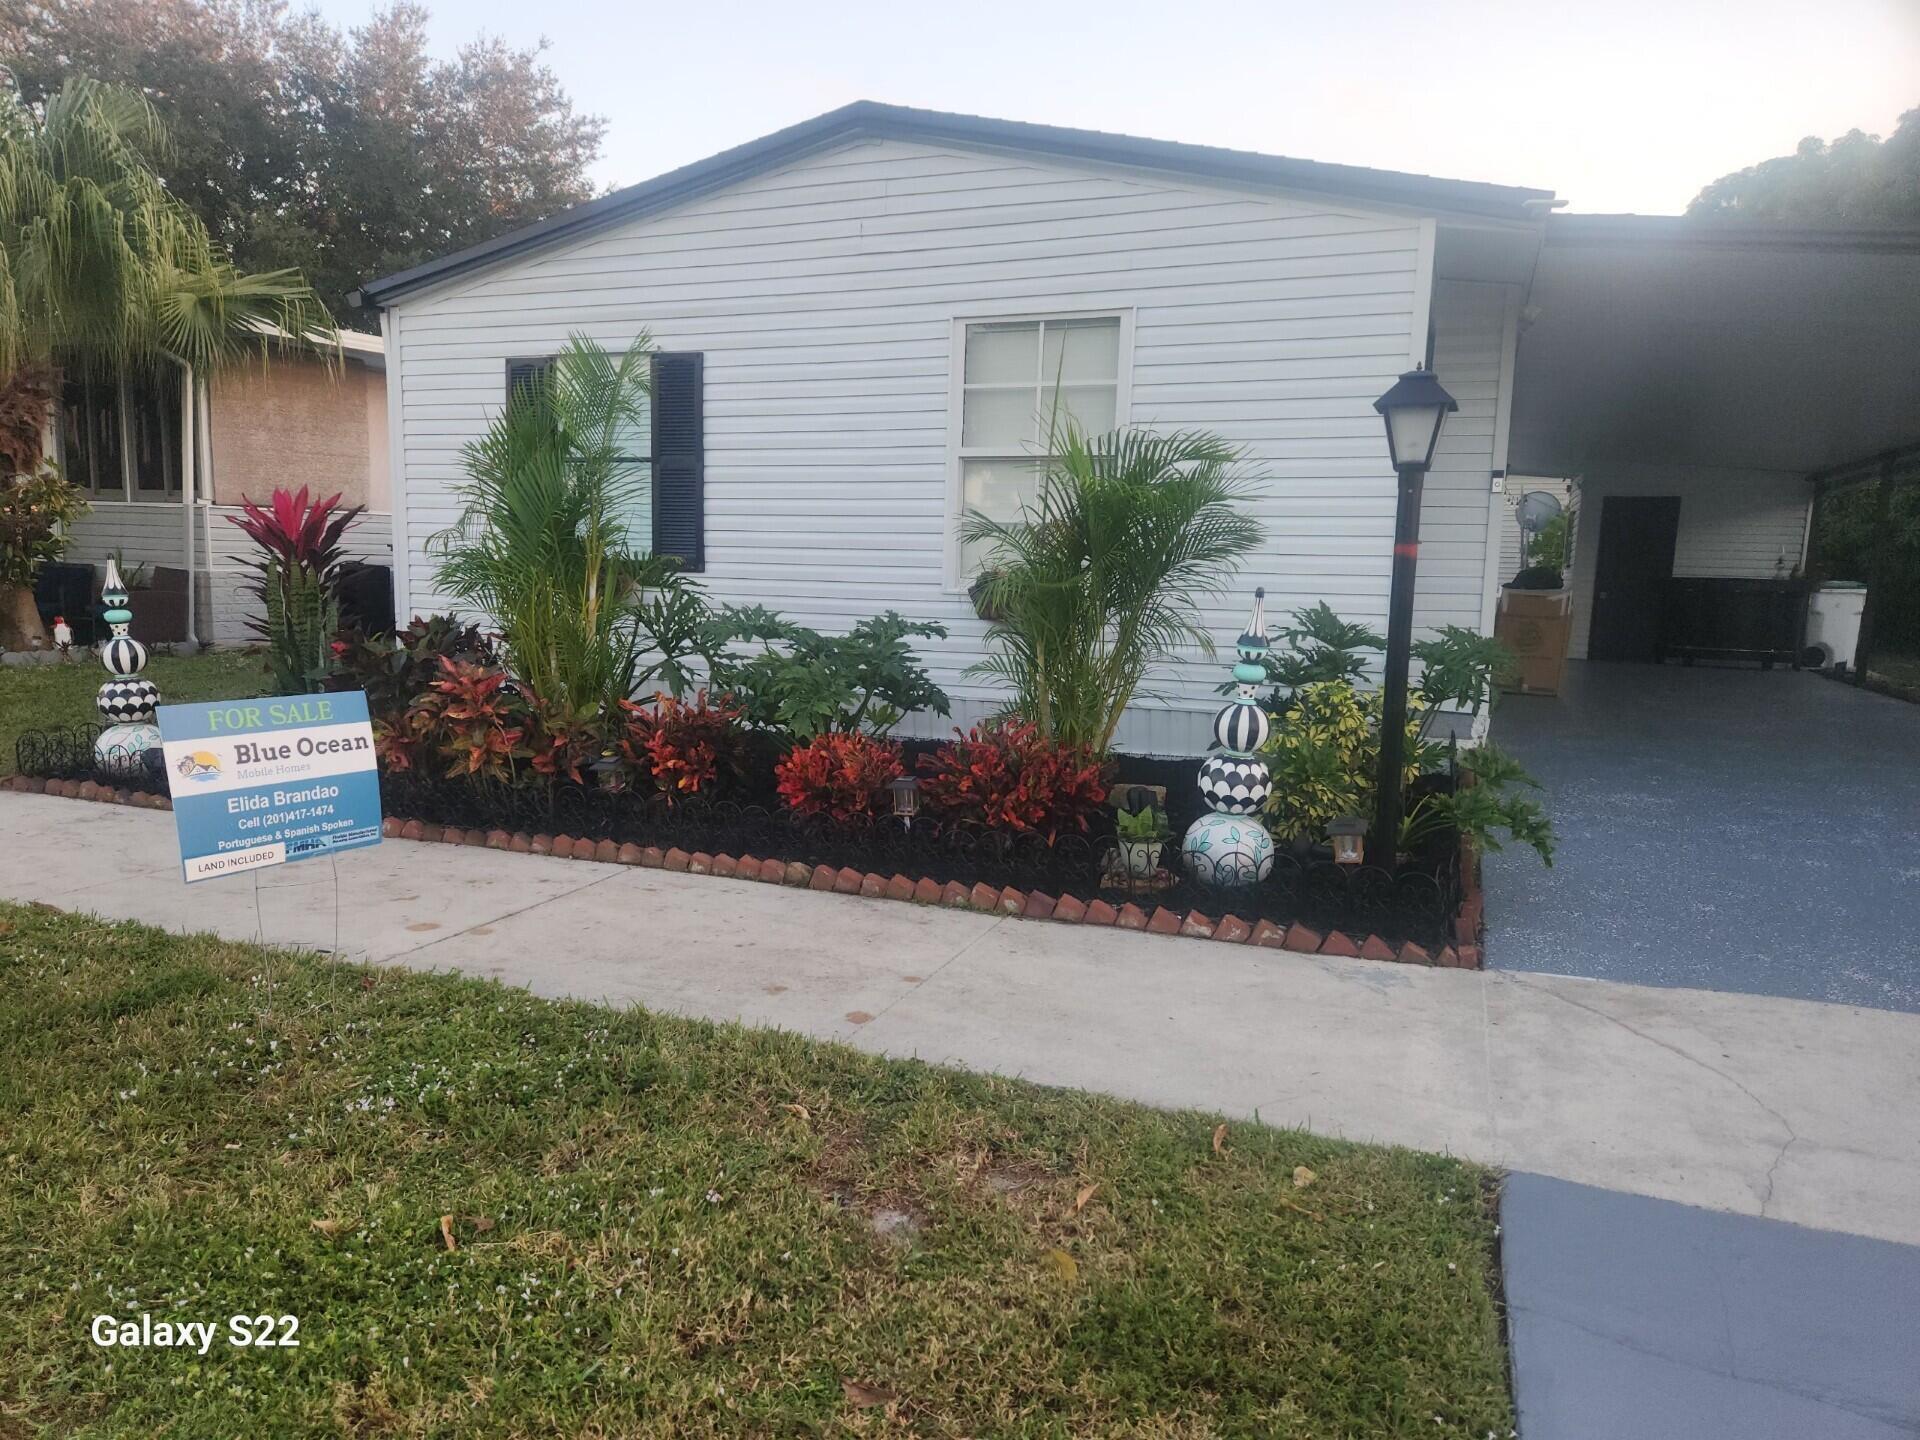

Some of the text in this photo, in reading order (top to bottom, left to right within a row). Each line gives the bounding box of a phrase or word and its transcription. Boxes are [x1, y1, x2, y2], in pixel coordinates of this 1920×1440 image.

[208, 701, 334, 731] FOR SALE
[234, 736, 369, 765] Blue Ocean
[237, 763, 311, 780] Mobile Homes
[228, 785, 339, 813] Elida Brandao
[238, 804, 334, 830] Cell (201)417-1474
[218, 834, 273, 851] Portuguese
[274, 830, 282, 839] &
[284, 826, 320, 839] Spanish
[321, 818, 354, 833] Spoken
[198, 851, 274, 873] LAND INCLUDED
